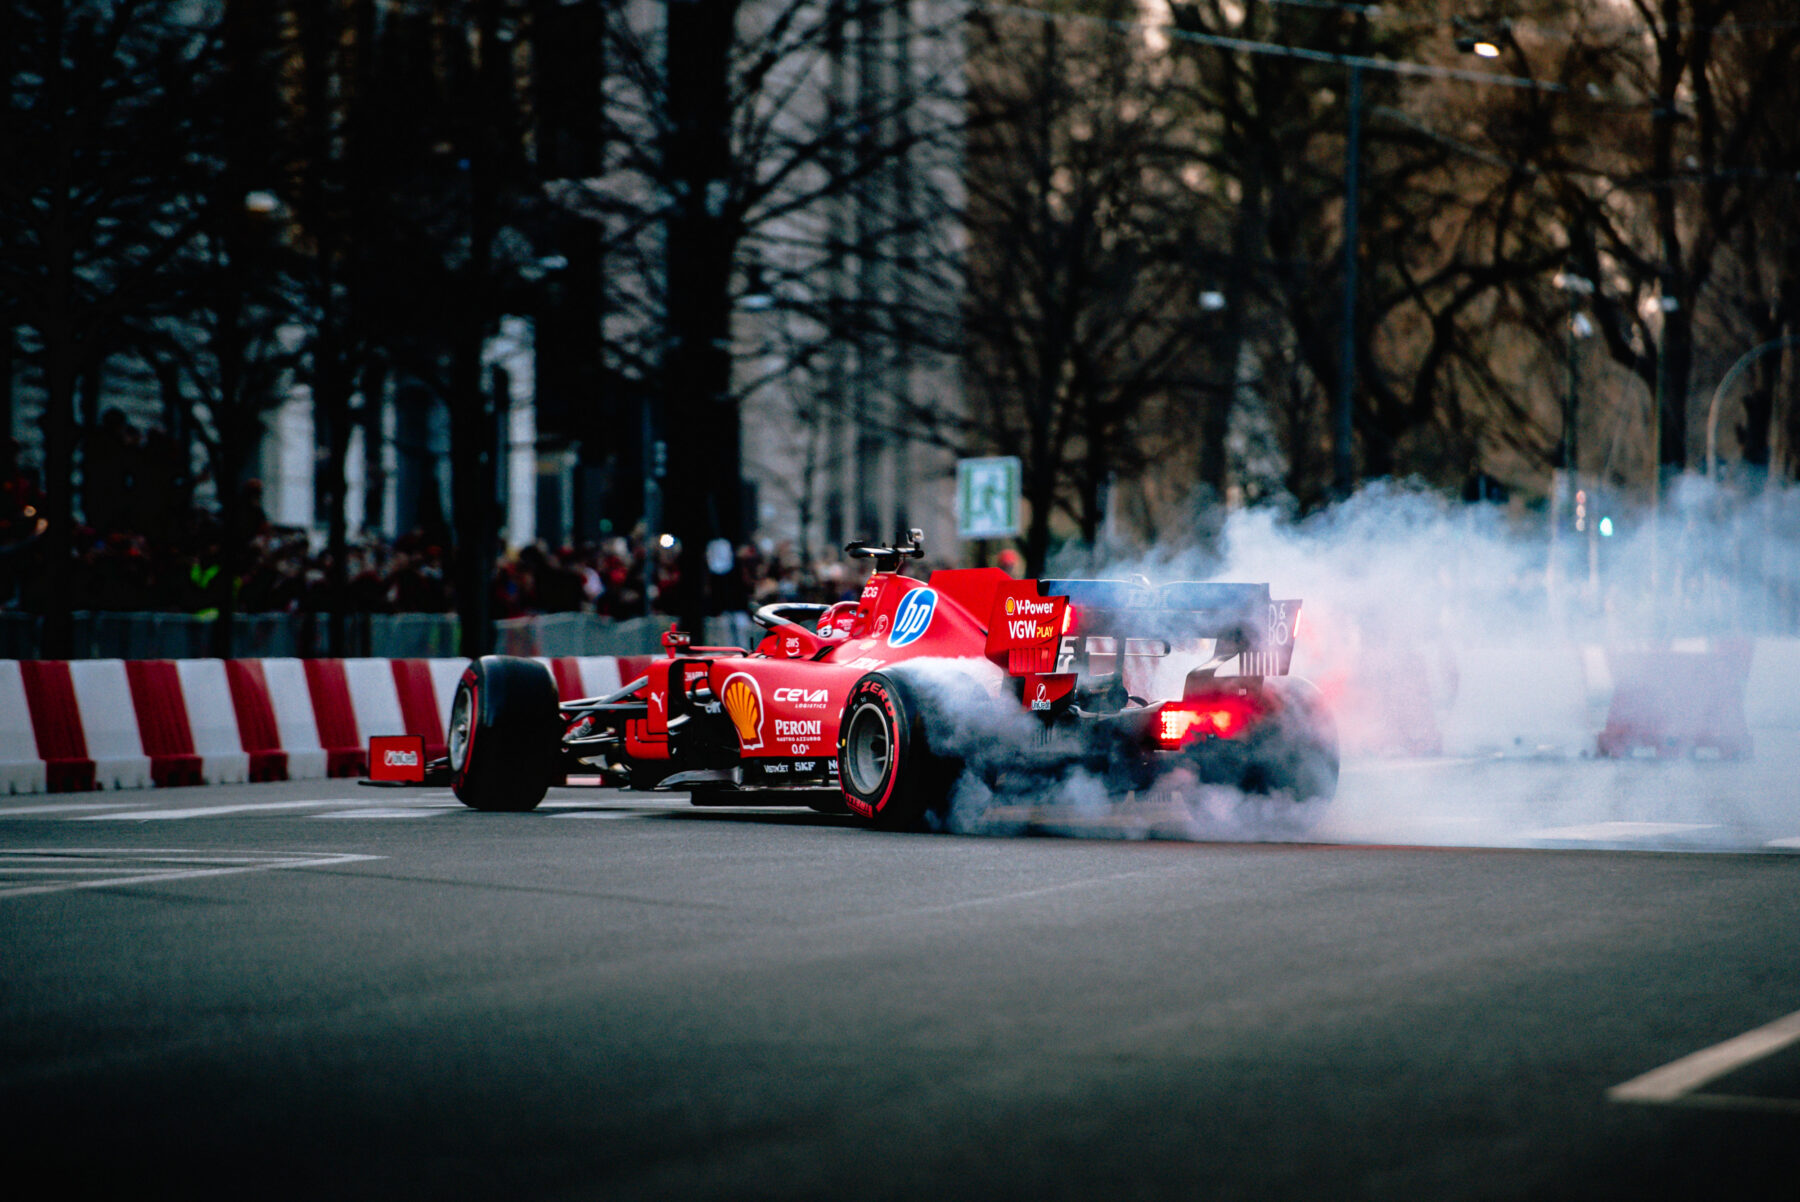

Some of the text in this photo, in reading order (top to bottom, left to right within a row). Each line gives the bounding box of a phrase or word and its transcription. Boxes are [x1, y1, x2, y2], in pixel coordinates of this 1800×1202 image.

[1015, 600, 1054, 615] V-Power
[860, 680, 897, 718] ZERO
[775, 719, 822, 735] PERONI
[795, 761, 816, 772] SKF
